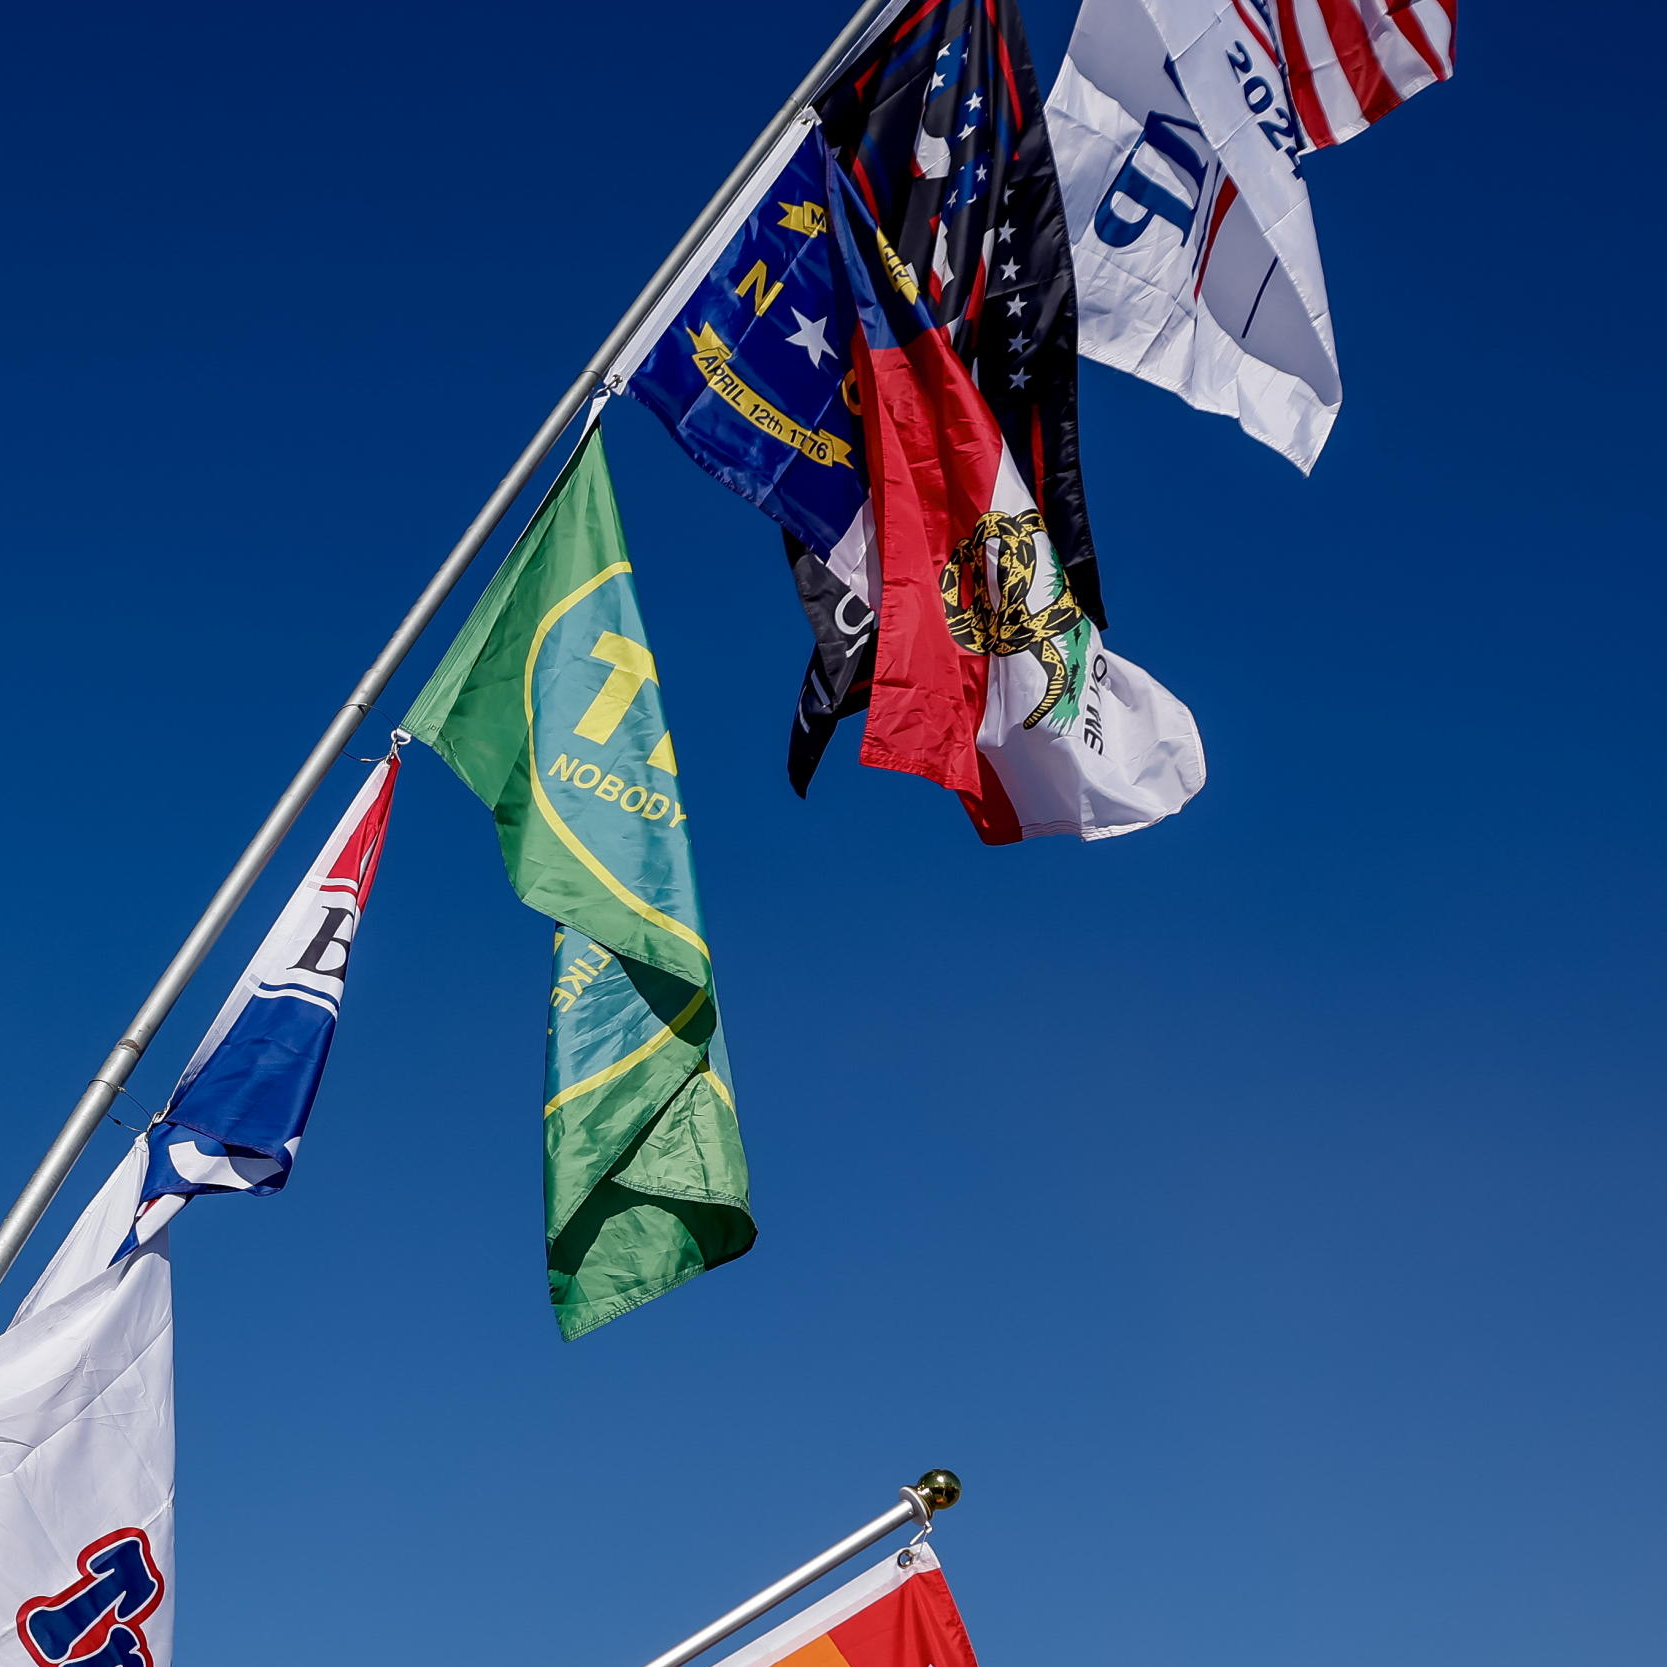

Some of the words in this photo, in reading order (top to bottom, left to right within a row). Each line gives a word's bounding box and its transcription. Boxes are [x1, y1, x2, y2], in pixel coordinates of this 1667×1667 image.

[735, 259, 784, 317] N
[698, 354, 744, 407] APRIL
[749, 403, 784, 437] 12th
[790, 422, 829, 461] 1776
[549, 753, 687, 832] NOBODY
